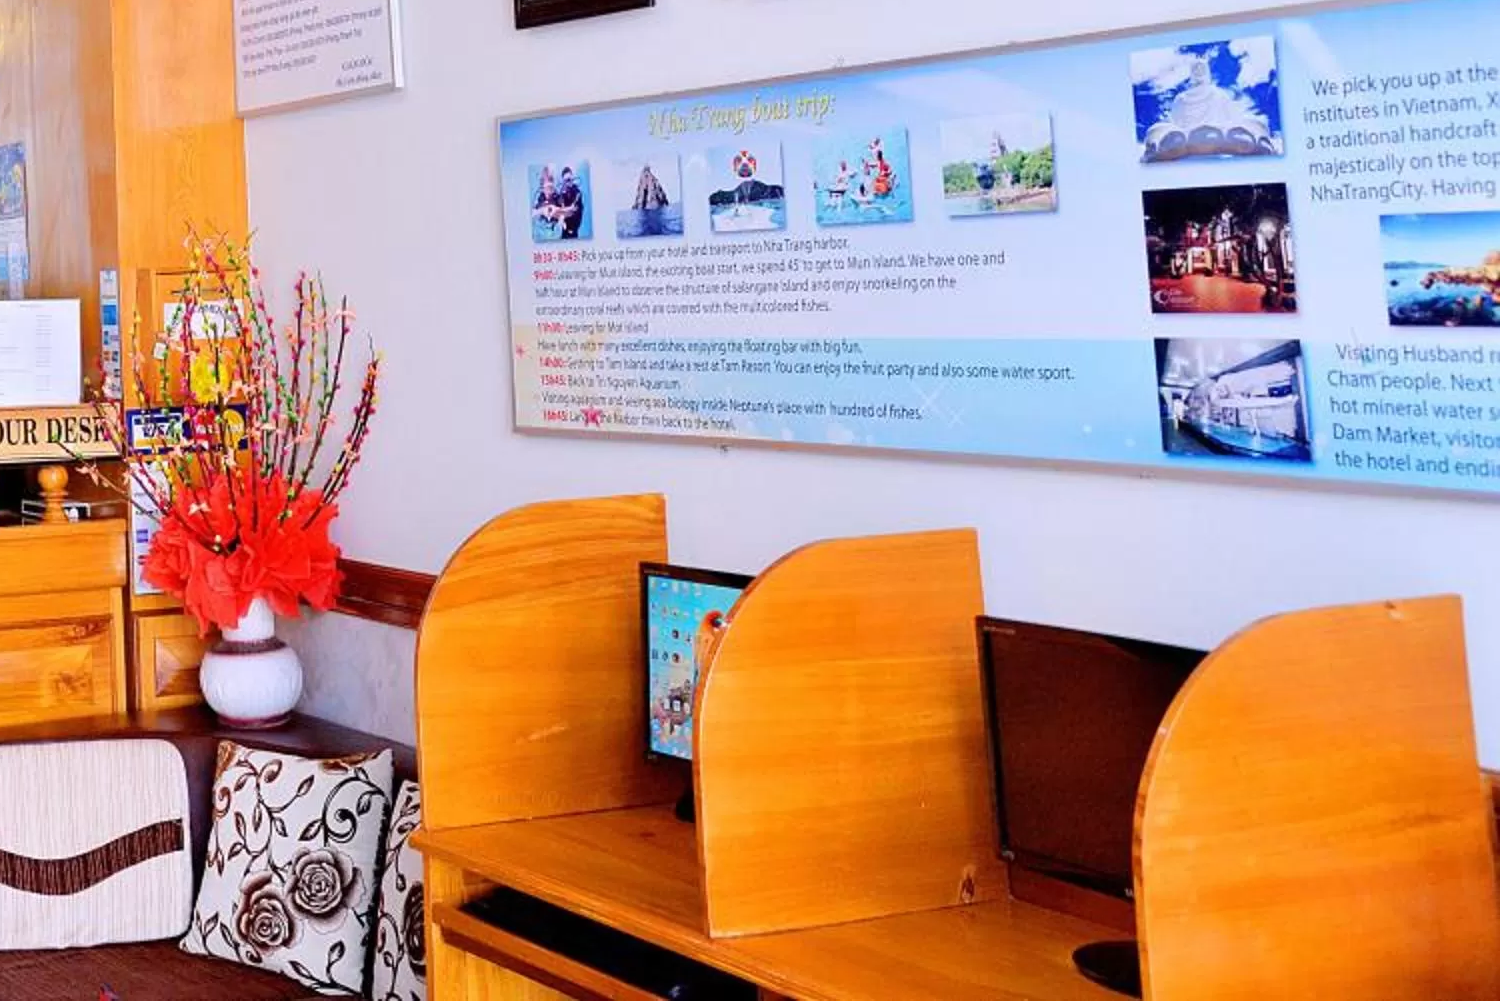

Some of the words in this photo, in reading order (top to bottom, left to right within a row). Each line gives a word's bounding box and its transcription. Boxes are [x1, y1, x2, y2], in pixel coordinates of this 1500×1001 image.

[1312, 79, 1340, 97] We
[1343, 75, 1377, 99] pick
[1380, 74, 1412, 95] you
[1417, 72, 1441, 90] up
[1445, 67, 1463, 84] at
[1467, 63, 1498, 83] the
[1303, 103, 1379, 123] institutes
[1383, 100, 1398, 117] in
[1402, 97, 1482, 116] Vietnam,
[1306, 136, 1315, 150] a
[1319, 126, 1405, 148] traditional
[1410, 119, 1496, 142] handcraft
[1309, 154, 1405, 179] majestically
[1411, 155, 1433, 170] on
[1437, 151, 1468, 168] the
[1432, 178, 1497, 199] Having
[668, 243, 688, 257] hotel
[691, 242, 706, 256] and
[784, 238, 812, 254] Trang
[695, 263, 714, 276] boat
[757, 259, 786, 276] spend
[802, 258, 813, 271] to
[815, 259, 832, 275] get
[833, 258, 844, 270] to
[908, 253, 926, 268] We
[928, 252, 955, 267] have
[957, 253, 980, 267] one
[983, 249, 1005, 266] and
[666, 284, 680, 296] the
[682, 283, 720, 296] structure
[811, 279, 830, 292] and
[832, 278, 860, 294] enjoy
[862, 276, 918, 294] snorkeling
[919, 277, 935, 290] on
[938, 275, 956, 289] the
[667, 301, 701, 314] covered
[687, 341, 726, 356] enjoying
[727, 339, 743, 353] the
[781, 337, 799, 353] bar
[800, 339, 822, 354] with
[823, 338, 840, 357] big
[1335, 342, 1399, 366] Visiting
[1403, 345, 1484, 364] Husband
[773, 359, 793, 375] You
[794, 361, 812, 375] can
[814, 360, 841, 379] enjoy
[843, 360, 861, 375] the
[862, 360, 885, 376] fruit
[887, 363, 915, 380] party
[917, 362, 939, 377] and
[942, 362, 965, 378] also
[966, 364, 999, 379] some
[1002, 366, 1035, 380] water
[1037, 366, 1075, 381] sport.
[1328, 369, 1376, 388] Cham
[1381, 372, 1446, 394] people.
[1451, 374, 1494, 392] Next
[803, 401, 826, 416] with
[830, 400, 874, 418] hundred
[1330, 396, 1359, 415] hot
[1363, 400, 1429, 417] mineral
[1433, 404, 1483, 420] water
[1333, 422, 1372, 441] Dam
[1377, 426, 1441, 448] Market,
[1335, 450, 1364, 469] the
[1367, 452, 1412, 472] hotel
[1416, 456, 1449, 474] and
